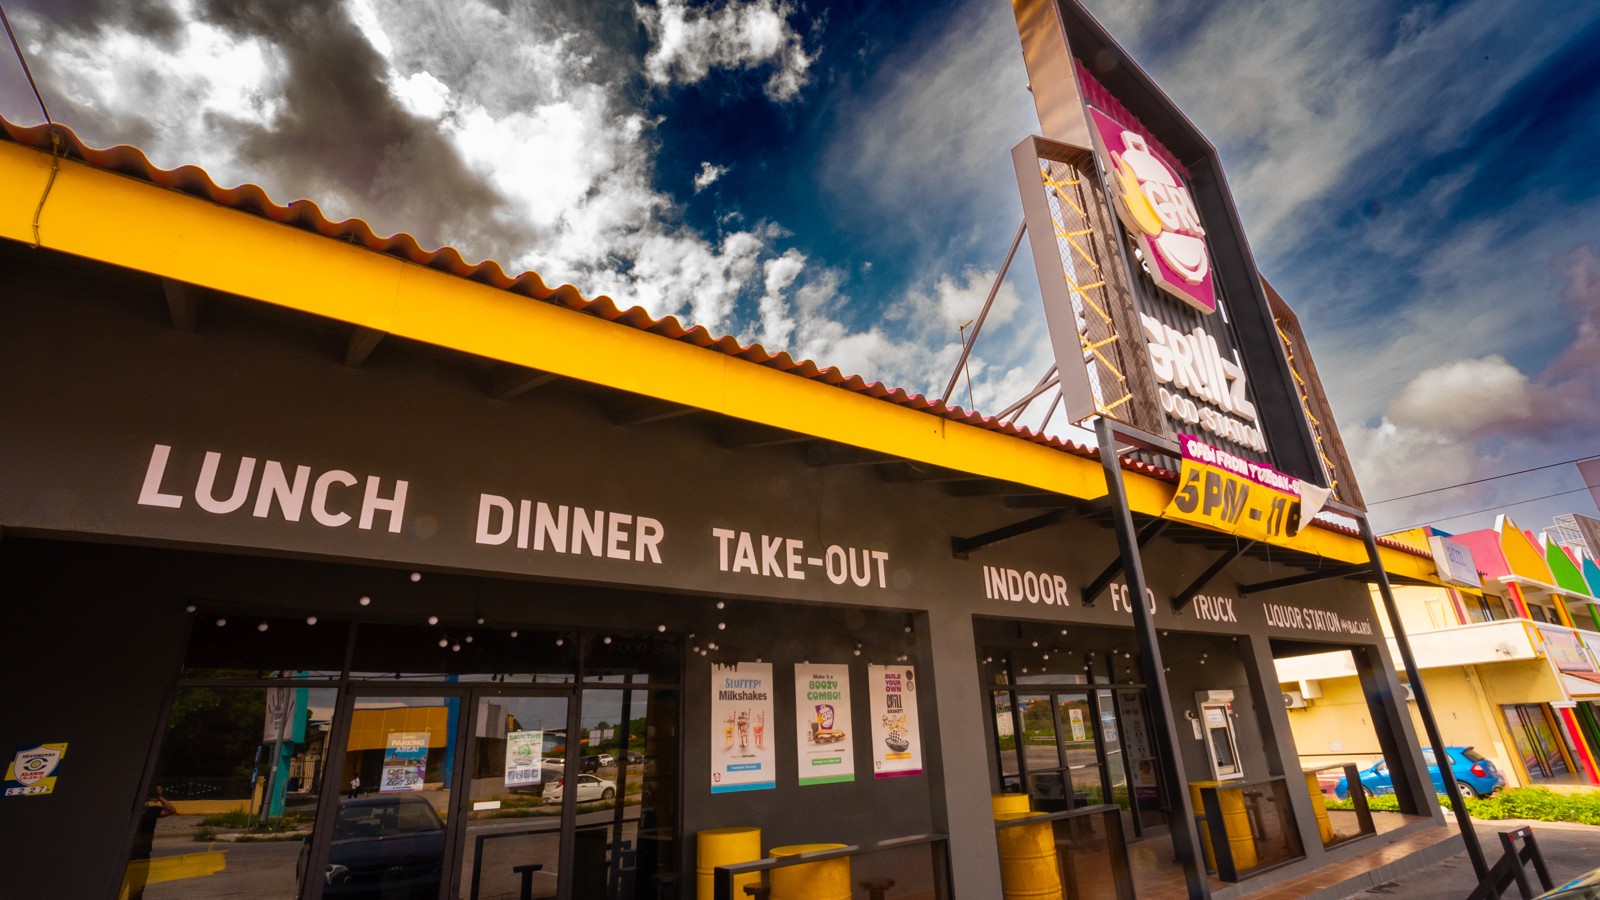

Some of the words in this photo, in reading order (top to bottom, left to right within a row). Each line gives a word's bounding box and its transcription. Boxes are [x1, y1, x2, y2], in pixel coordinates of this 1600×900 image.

[1159, 388, 1199, 425] OOD
[1199, 407, 1267, 453] STATION
[1187, 440, 1216, 462] OPEN
[1216, 450, 1249, 476] FROM
[137, 444, 409, 533] LUNCH
[1174, 468, 1249, 525] 5PM
[475, 492, 665, 564] DINNER
[712, 527, 889, 588] TAKE-OUT
[982, 565, 1070, 606] INDOOR
[1109, 582, 1157, 615] FOD
[1193, 594, 1237, 623] TRUCK
[1262, 602, 1305, 629] LIQUOR
[1303, 607, 1342, 632] STATION
[718, 690, 768, 701] Milkshakes
[807, 691, 841, 701] COMBO!
[809, 680, 838, 690] BOOZY
[391, 739, 425, 747] PARKING
